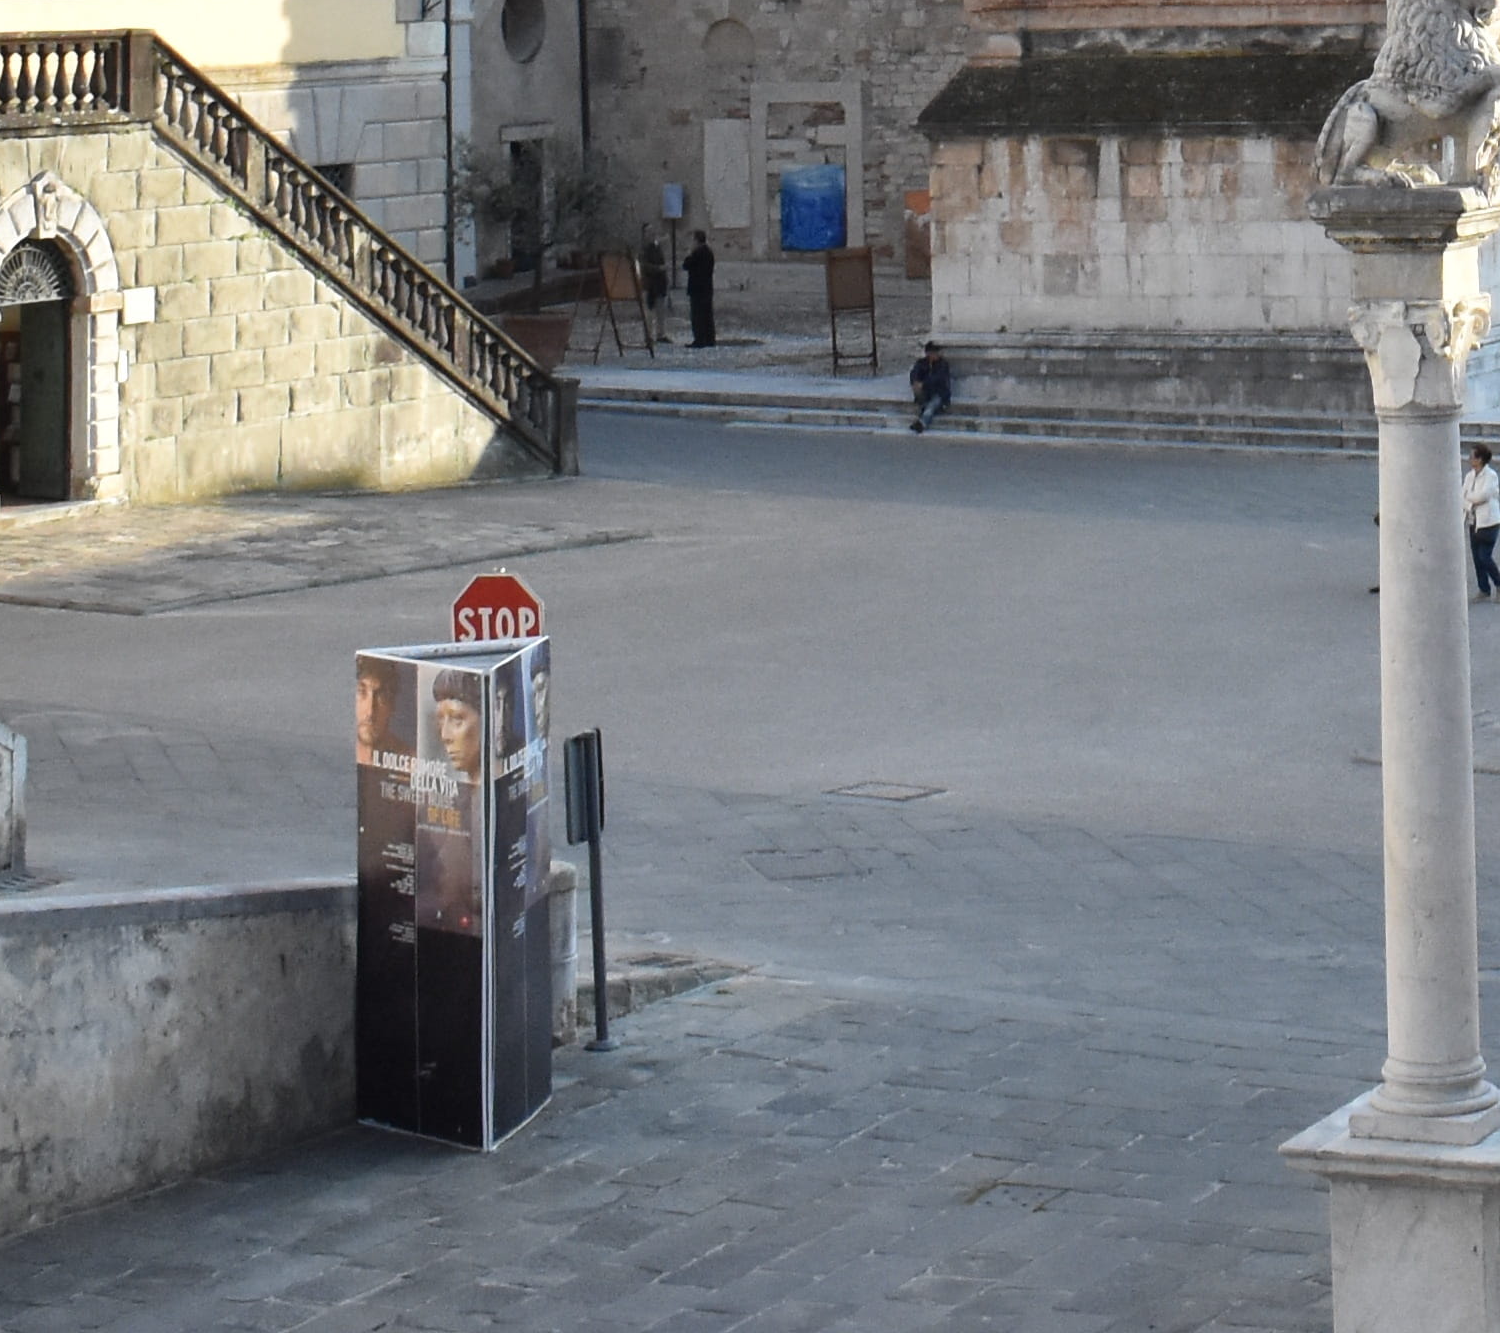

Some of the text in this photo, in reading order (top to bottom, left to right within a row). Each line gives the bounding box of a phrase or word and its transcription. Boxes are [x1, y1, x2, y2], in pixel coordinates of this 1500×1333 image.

[458, 607, 536, 641] STOP
[373, 750, 381, 767] IL
[382, 751, 410, 773] DOLCE
[411, 757, 447, 779] RUMORE
[410, 772, 437, 795] DELLA
[439, 777, 459, 797] VITA
